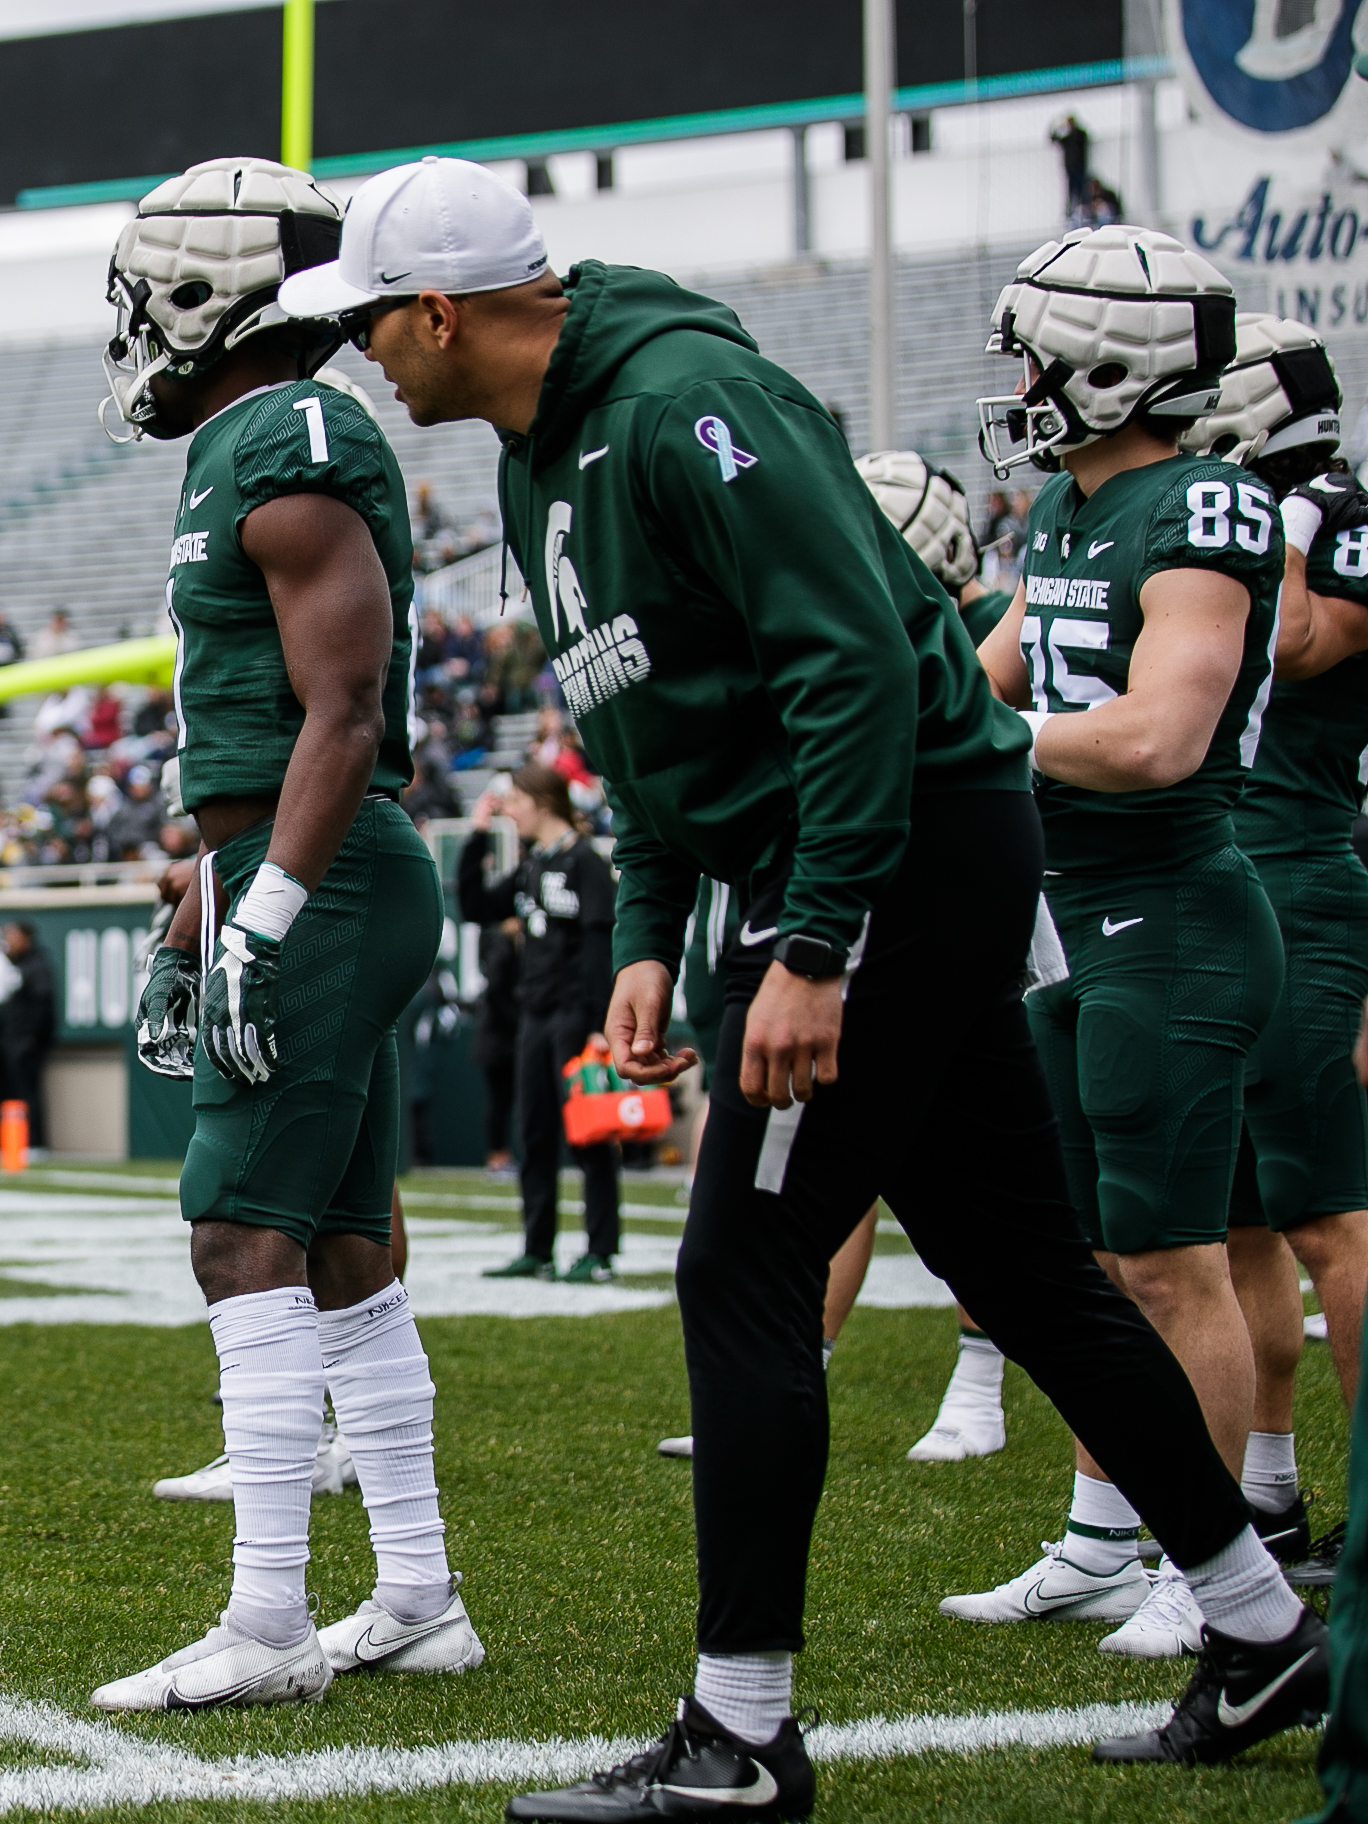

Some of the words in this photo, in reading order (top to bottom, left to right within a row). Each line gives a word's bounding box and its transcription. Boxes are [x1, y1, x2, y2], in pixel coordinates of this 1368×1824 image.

[293, 397, 329, 463] 1
[1187, 481, 1273, 555] 85
[1333, 525, 1368, 578] 8
[1066, 579, 1111, 611] STATE
[1109, 1528, 1137, 1538] NIKE
